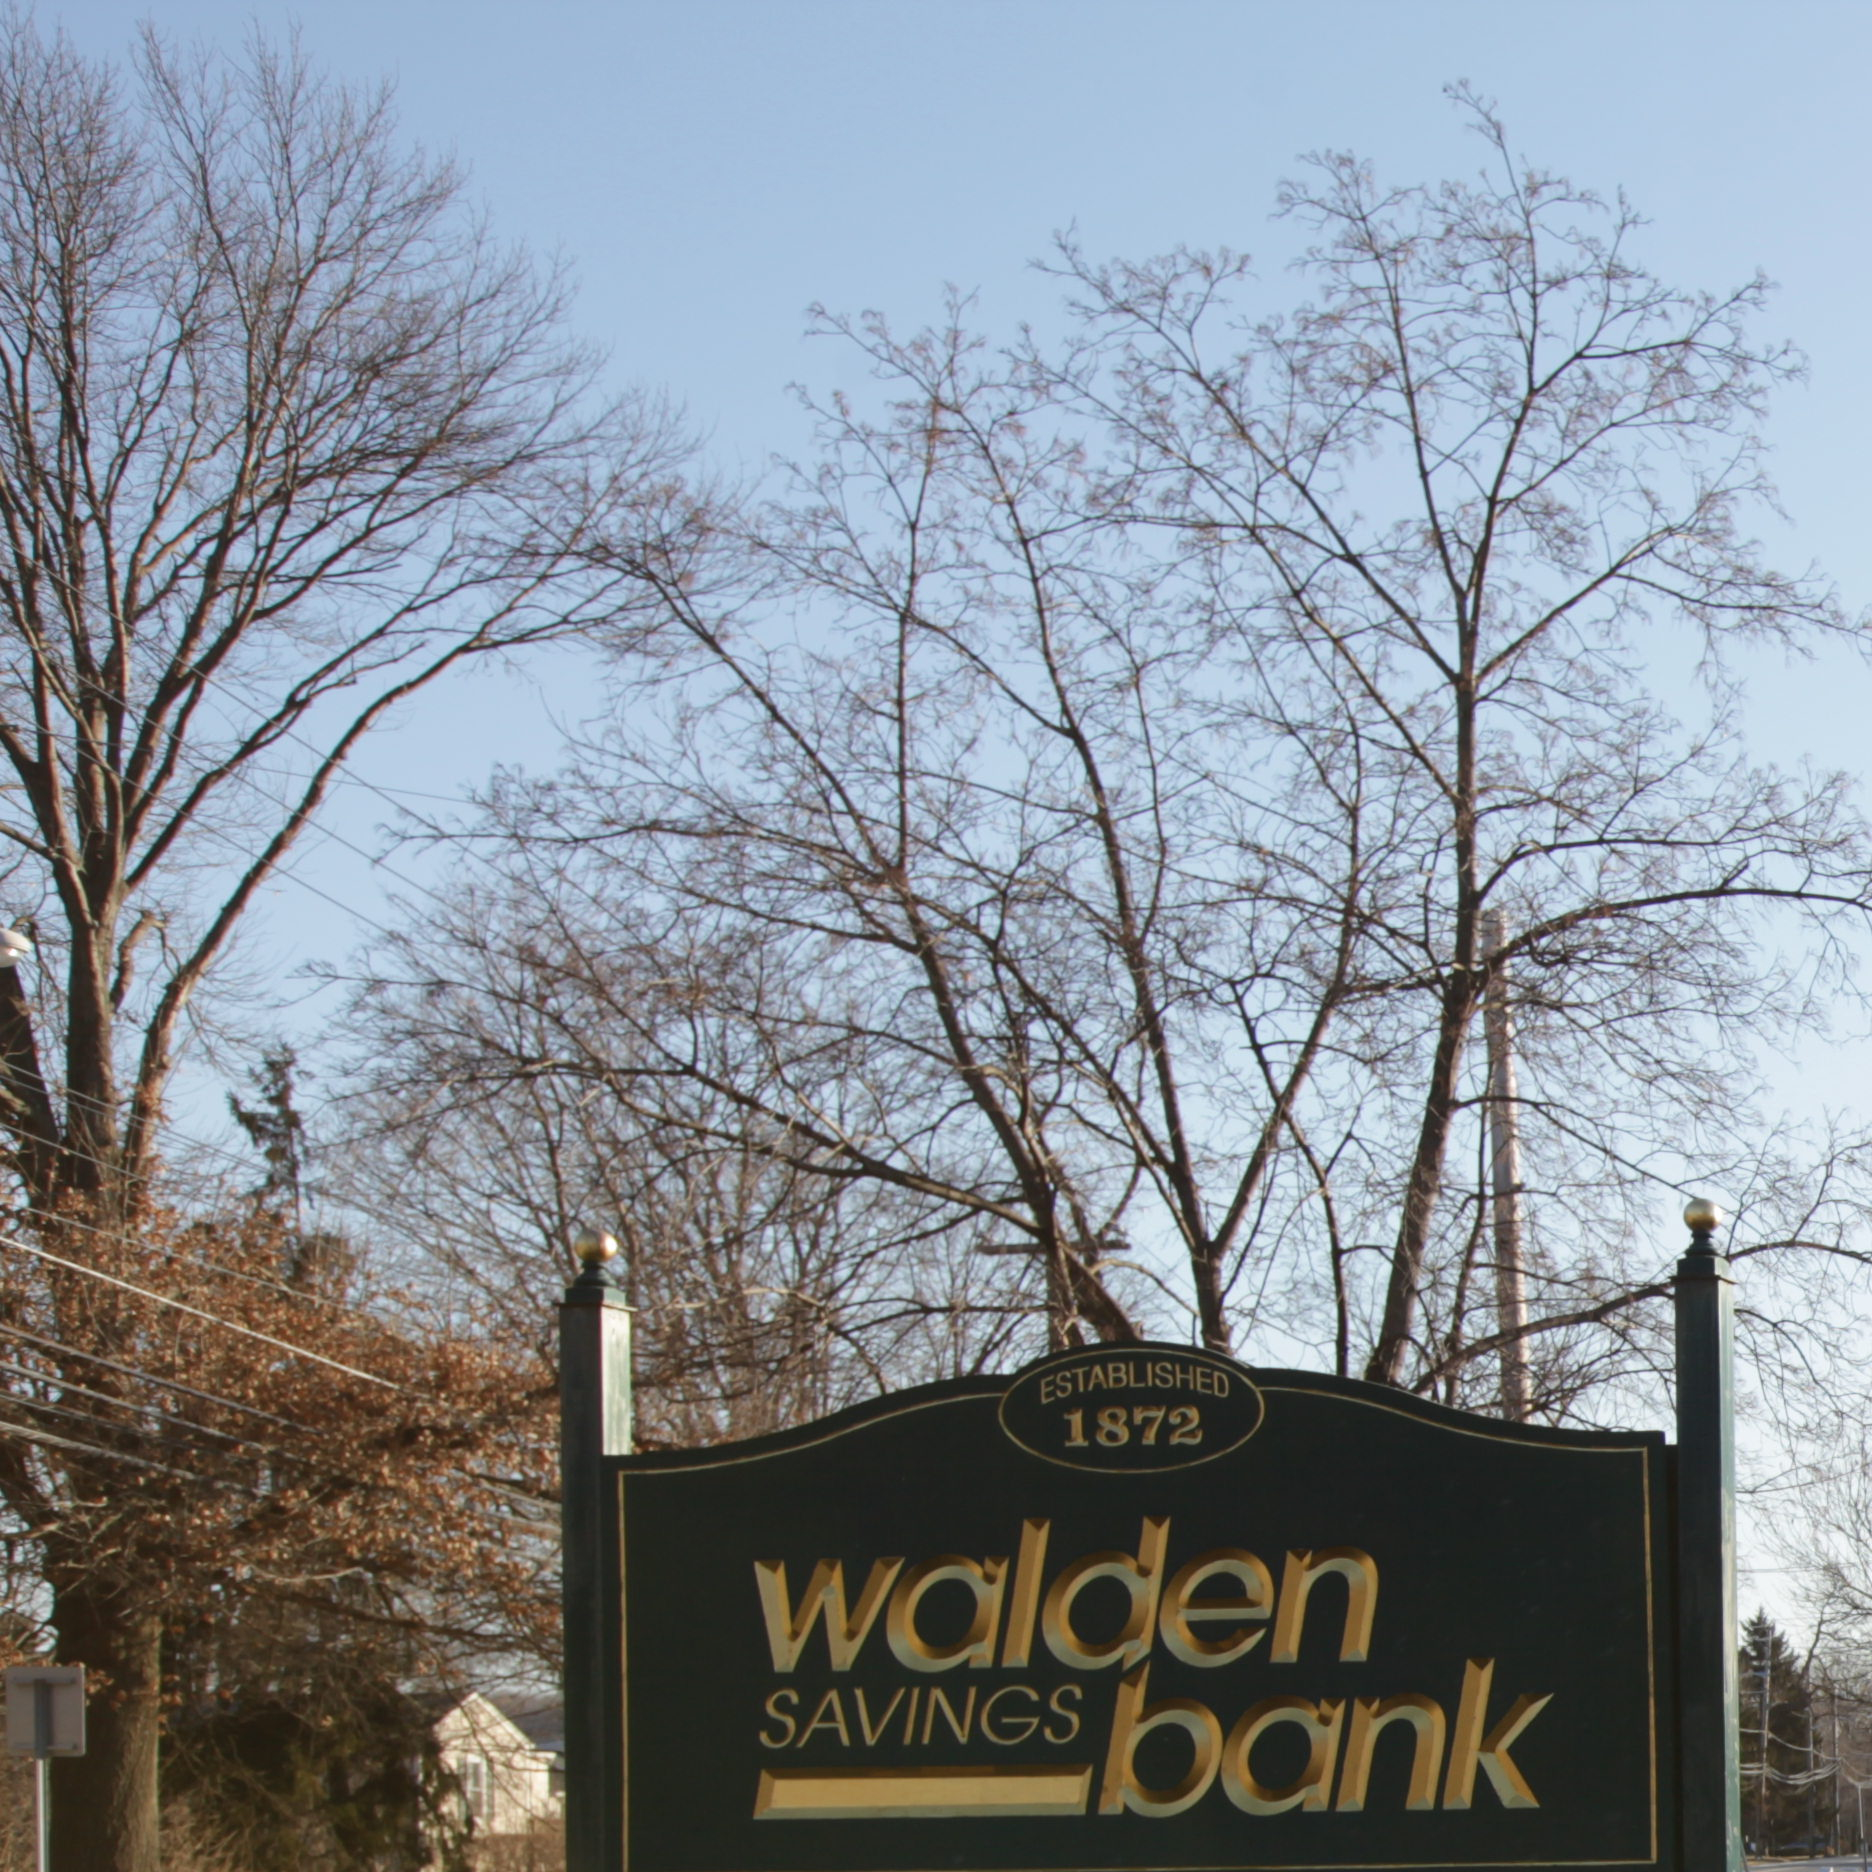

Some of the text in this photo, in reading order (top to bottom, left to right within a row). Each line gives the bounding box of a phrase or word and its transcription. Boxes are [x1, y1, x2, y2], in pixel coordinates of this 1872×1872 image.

[1040, 1361, 1230, 1404] ESTABLISHED
[1063, 1404, 1204, 1448] 1872
[753, 1515, 1380, 1673] walden
[758, 1684, 1083, 1748] SAVINGS
[1098, 1656, 1555, 1819] bank
